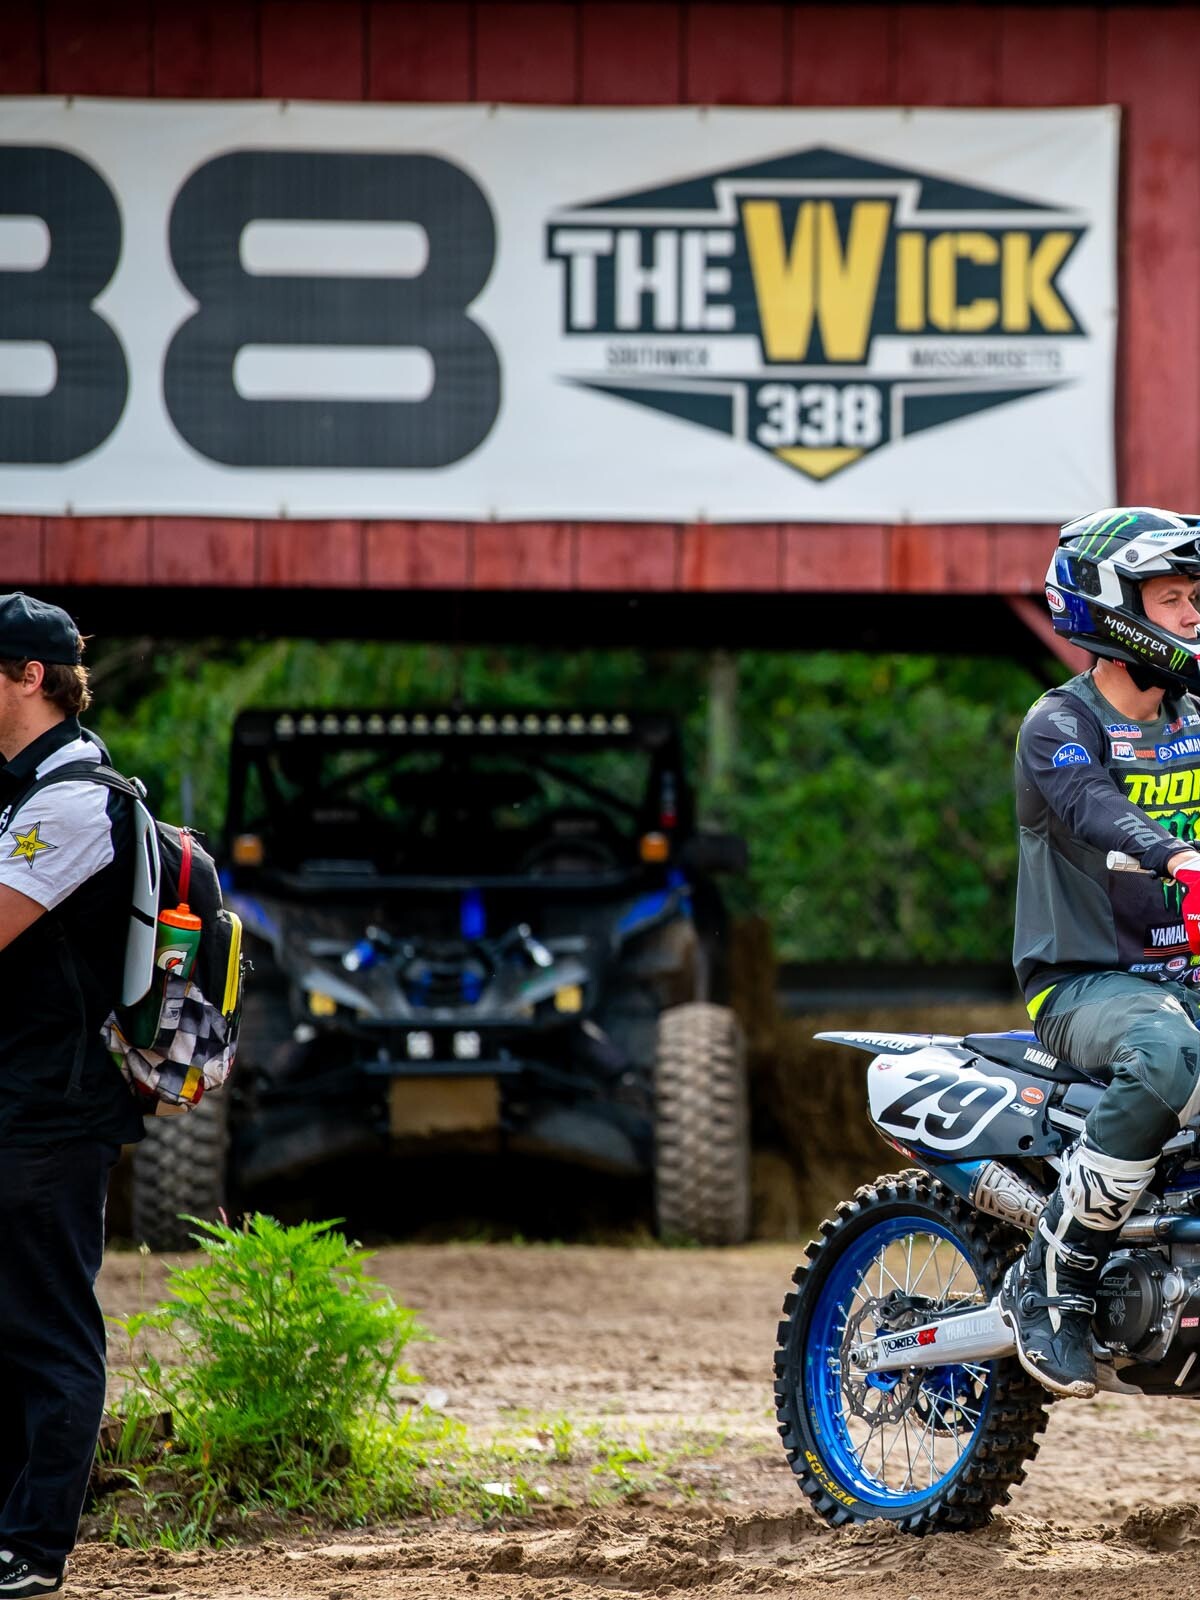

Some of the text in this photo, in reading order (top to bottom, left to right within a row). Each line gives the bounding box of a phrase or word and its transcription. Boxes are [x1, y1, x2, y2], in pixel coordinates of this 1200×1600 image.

[553, 201, 1077, 363] THE WICK
[757, 382, 882, 448] 338
[1047, 592, 1061, 608] BELL
[1110, 631, 1155, 657] ENERGY
[1151, 924, 1189, 947] YAMAL
[1168, 960, 1185, 968] BELL
[1023, 1047, 1058, 1070] YAMAHA
[877, 1068, 1008, 1140] 29
[881, 1332, 919, 1358] VORTEX
